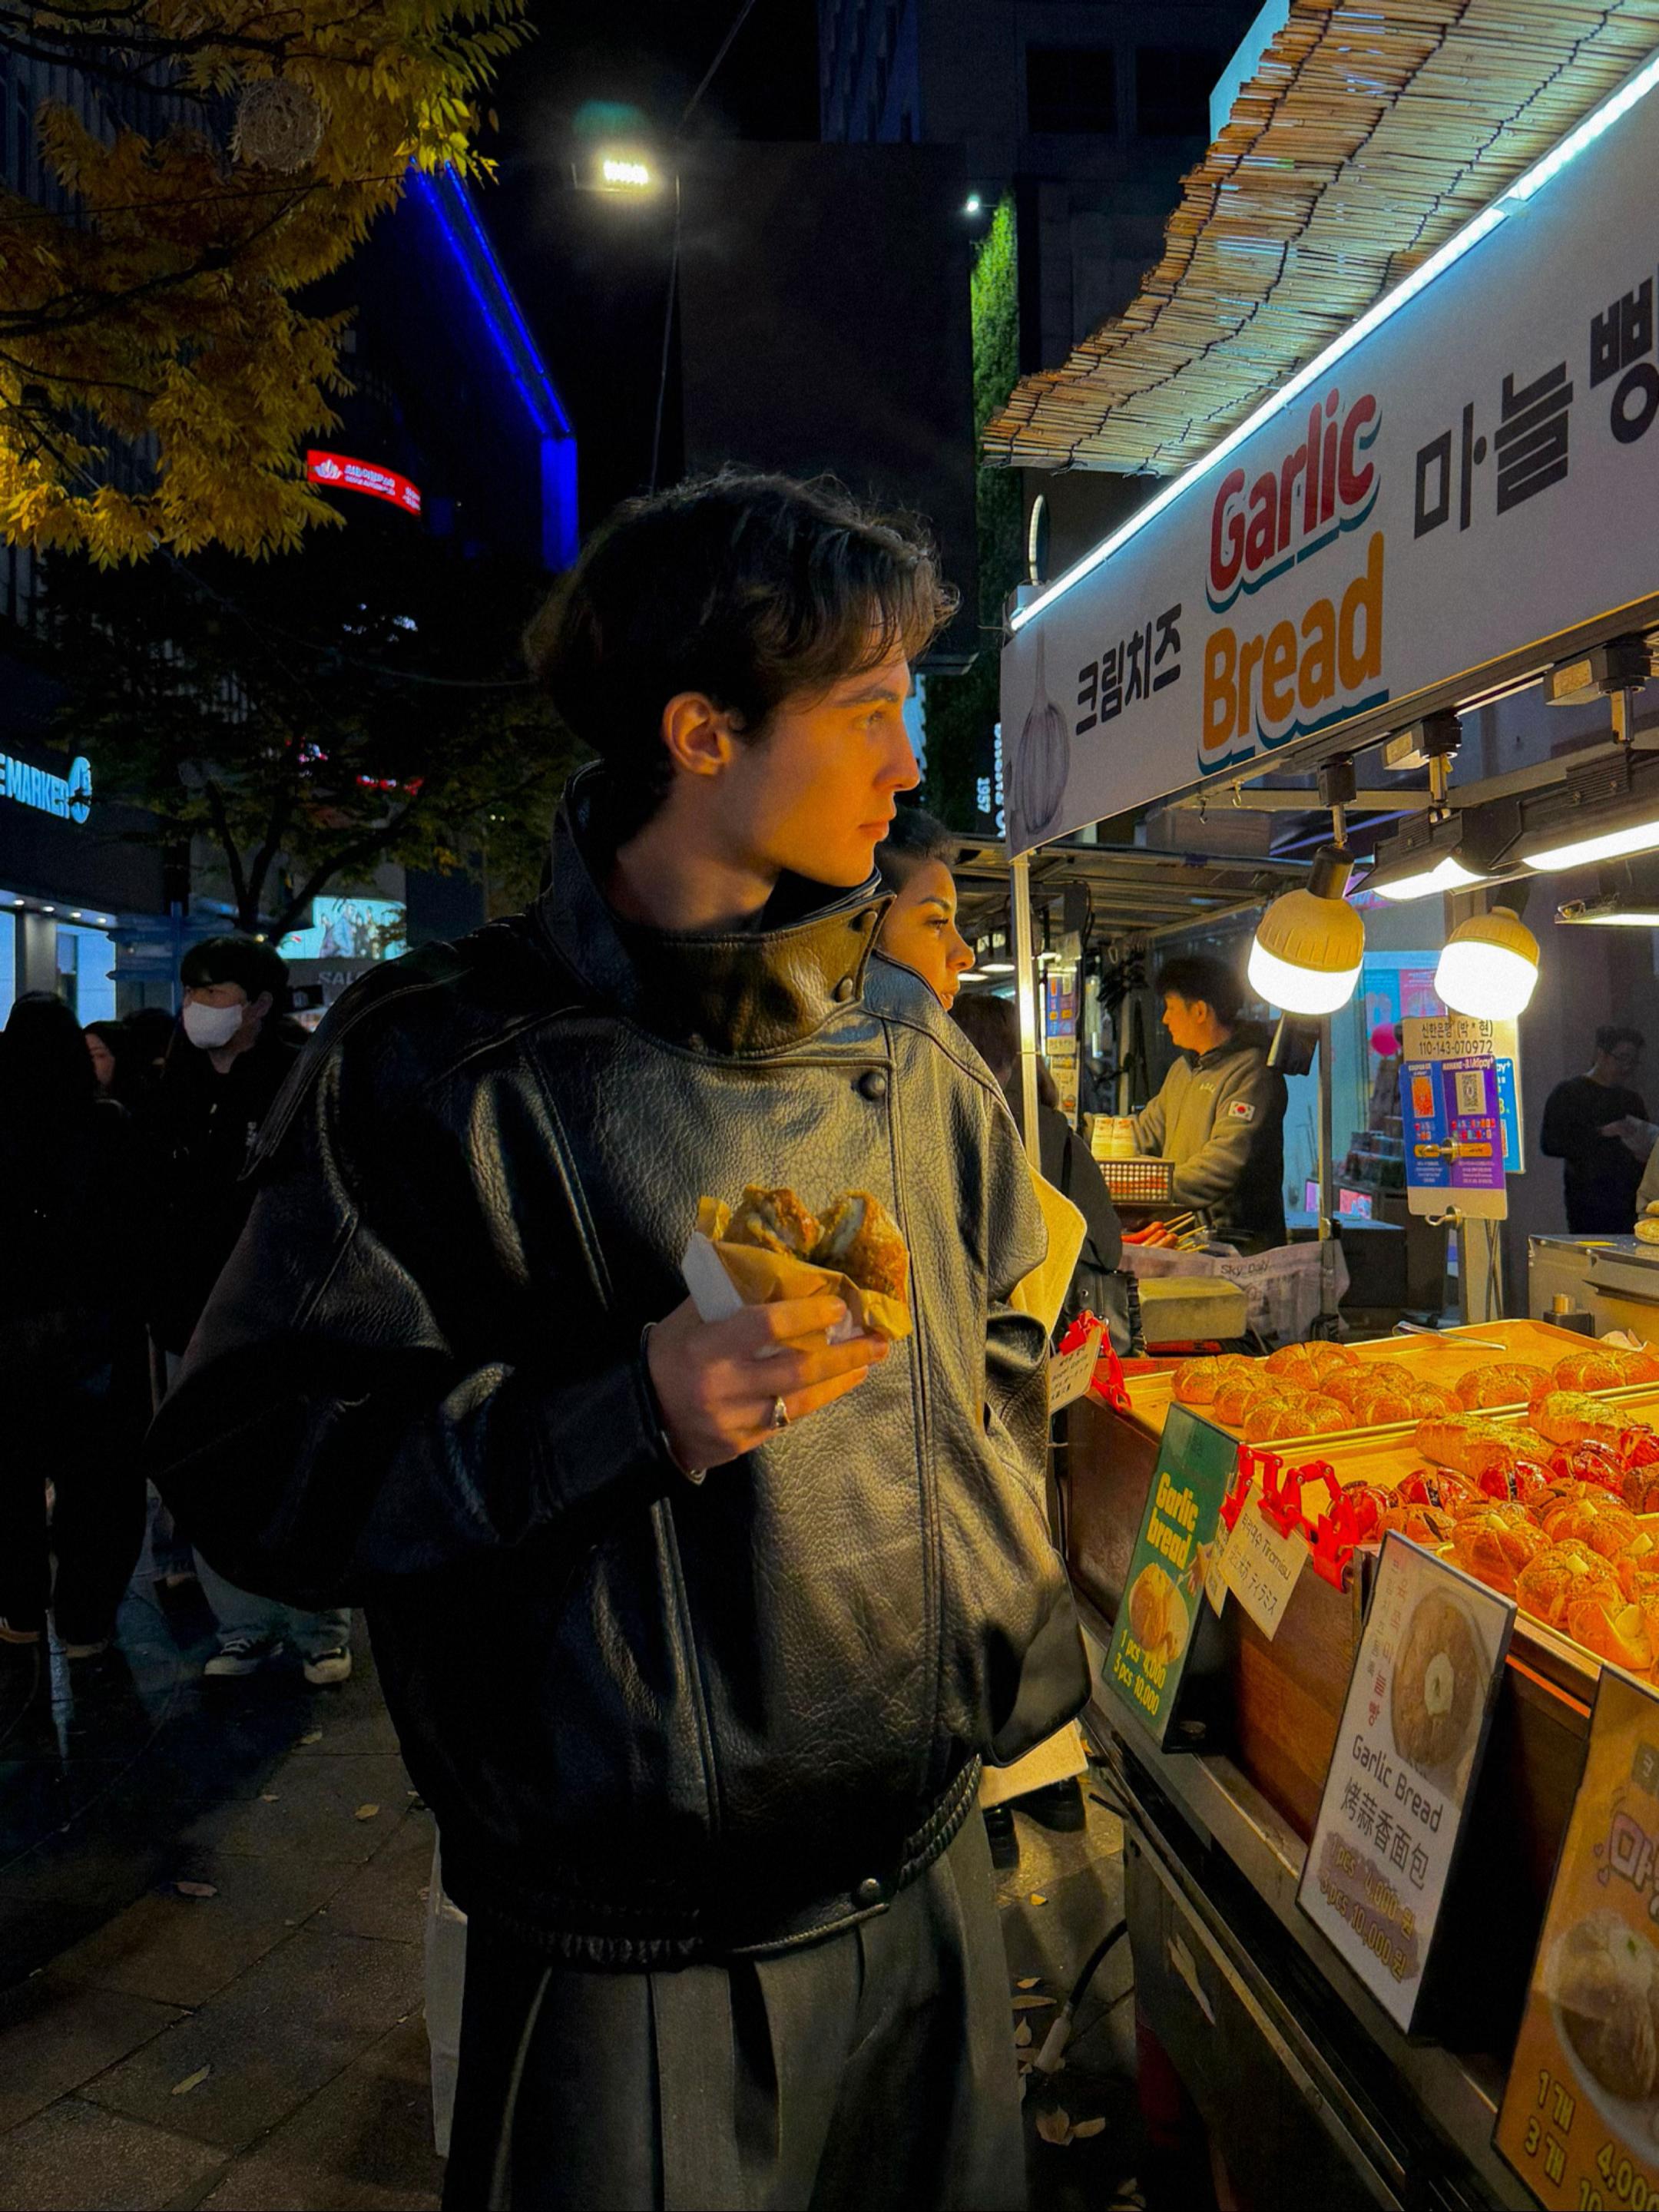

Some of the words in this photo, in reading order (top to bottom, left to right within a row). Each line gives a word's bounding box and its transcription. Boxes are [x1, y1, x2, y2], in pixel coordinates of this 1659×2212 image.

[1208, 386, 1379, 594] Garlic
[1076, 603, 1182, 735] 크림치즈
[1202, 531, 1384, 754] Bread
[977, 777, 991, 814] 1957
[1419, 1040, 1493, 1055] 110-143-070972
[1422, 1022, 1452, 1038] 신한은행
[1221, 1264, 1242, 1276] Sky
[1155, 1471, 1200, 1534] Garlic
[1146, 1508, 1193, 1570] bread
[1118, 1663, 1133, 1687] pcs
[1121, 1629, 1128, 1647] 1
[1126, 1639, 1141, 1663] pcs
[1352, 1734, 1391, 1792] Garlic
[1395, 1774, 1443, 1833] Bread
[1342, 1776, 1430, 1892] 烤蒜香面包
[1335, 1846, 1356, 1879] pcs
[1363, 1870, 1399, 1920] 4,000
[1401, 1906, 1416, 1941] 원
[1350, 1903, 1392, 1966] 10,000
[1389, 1948, 1407, 1984] 원
[1539, 2070, 1549, 2108] 1
[1553, 2081, 1575, 2134] 개
[1525, 2117, 1540, 2156] 3
[1545, 2132, 1565, 2187] 개
